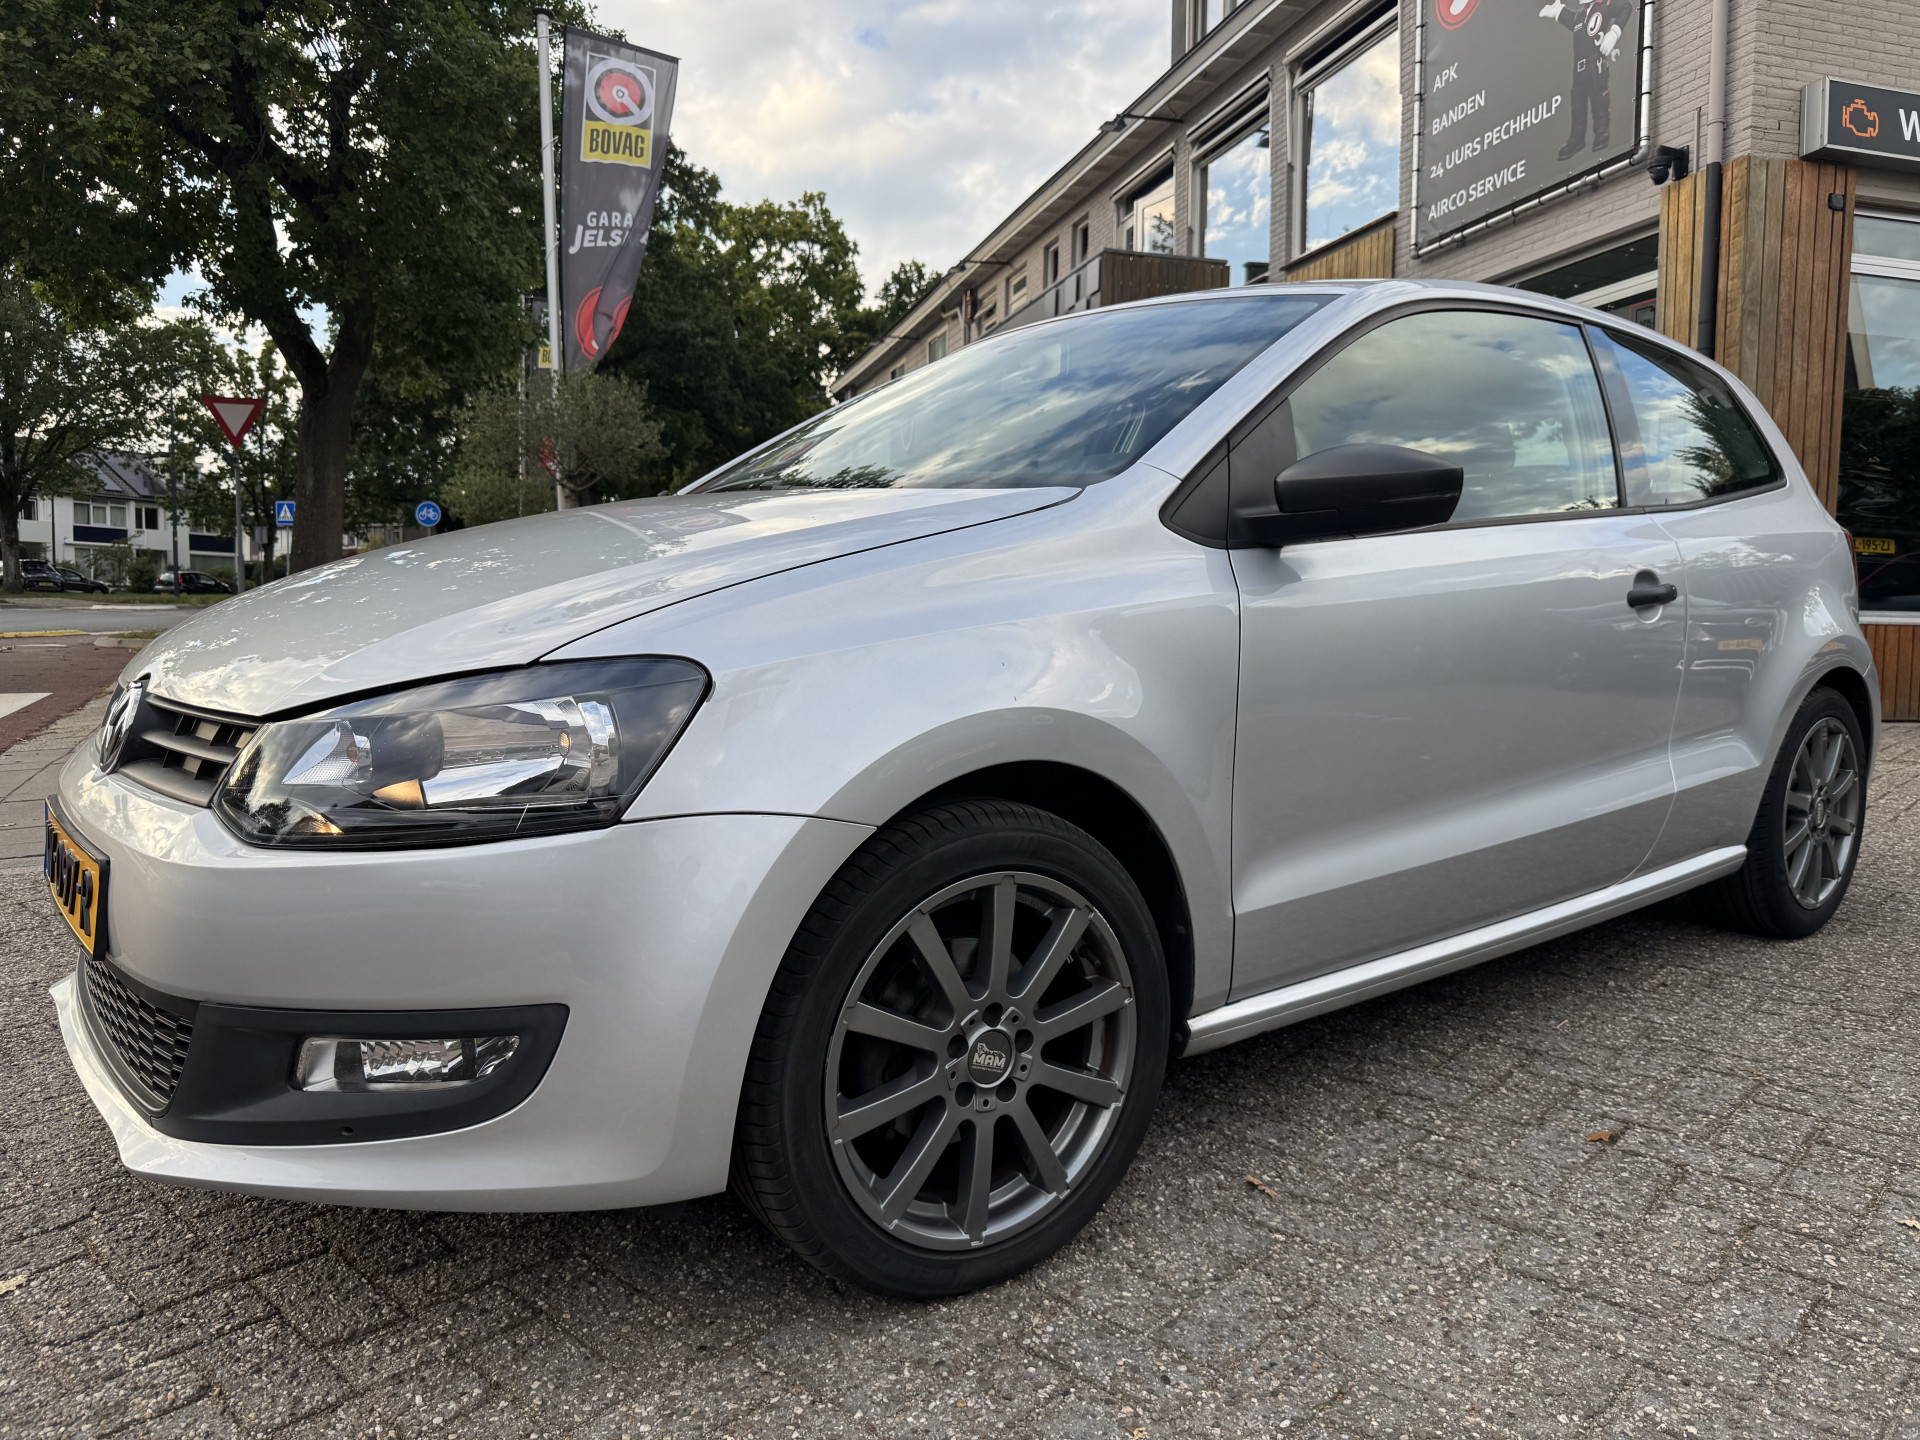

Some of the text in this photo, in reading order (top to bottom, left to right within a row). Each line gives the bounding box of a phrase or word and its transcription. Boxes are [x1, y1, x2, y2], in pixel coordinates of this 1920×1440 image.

[1433, 62, 1459, 92] APK
[1432, 90, 1485, 135] BANDEN
[589, 128, 645, 158] BOVAG
[1429, 95, 1562, 179] 24 UURS PECHHULP
[1428, 160, 1527, 221] AIRCO SERVICE
[973, 1052, 1006, 1069] MAM
